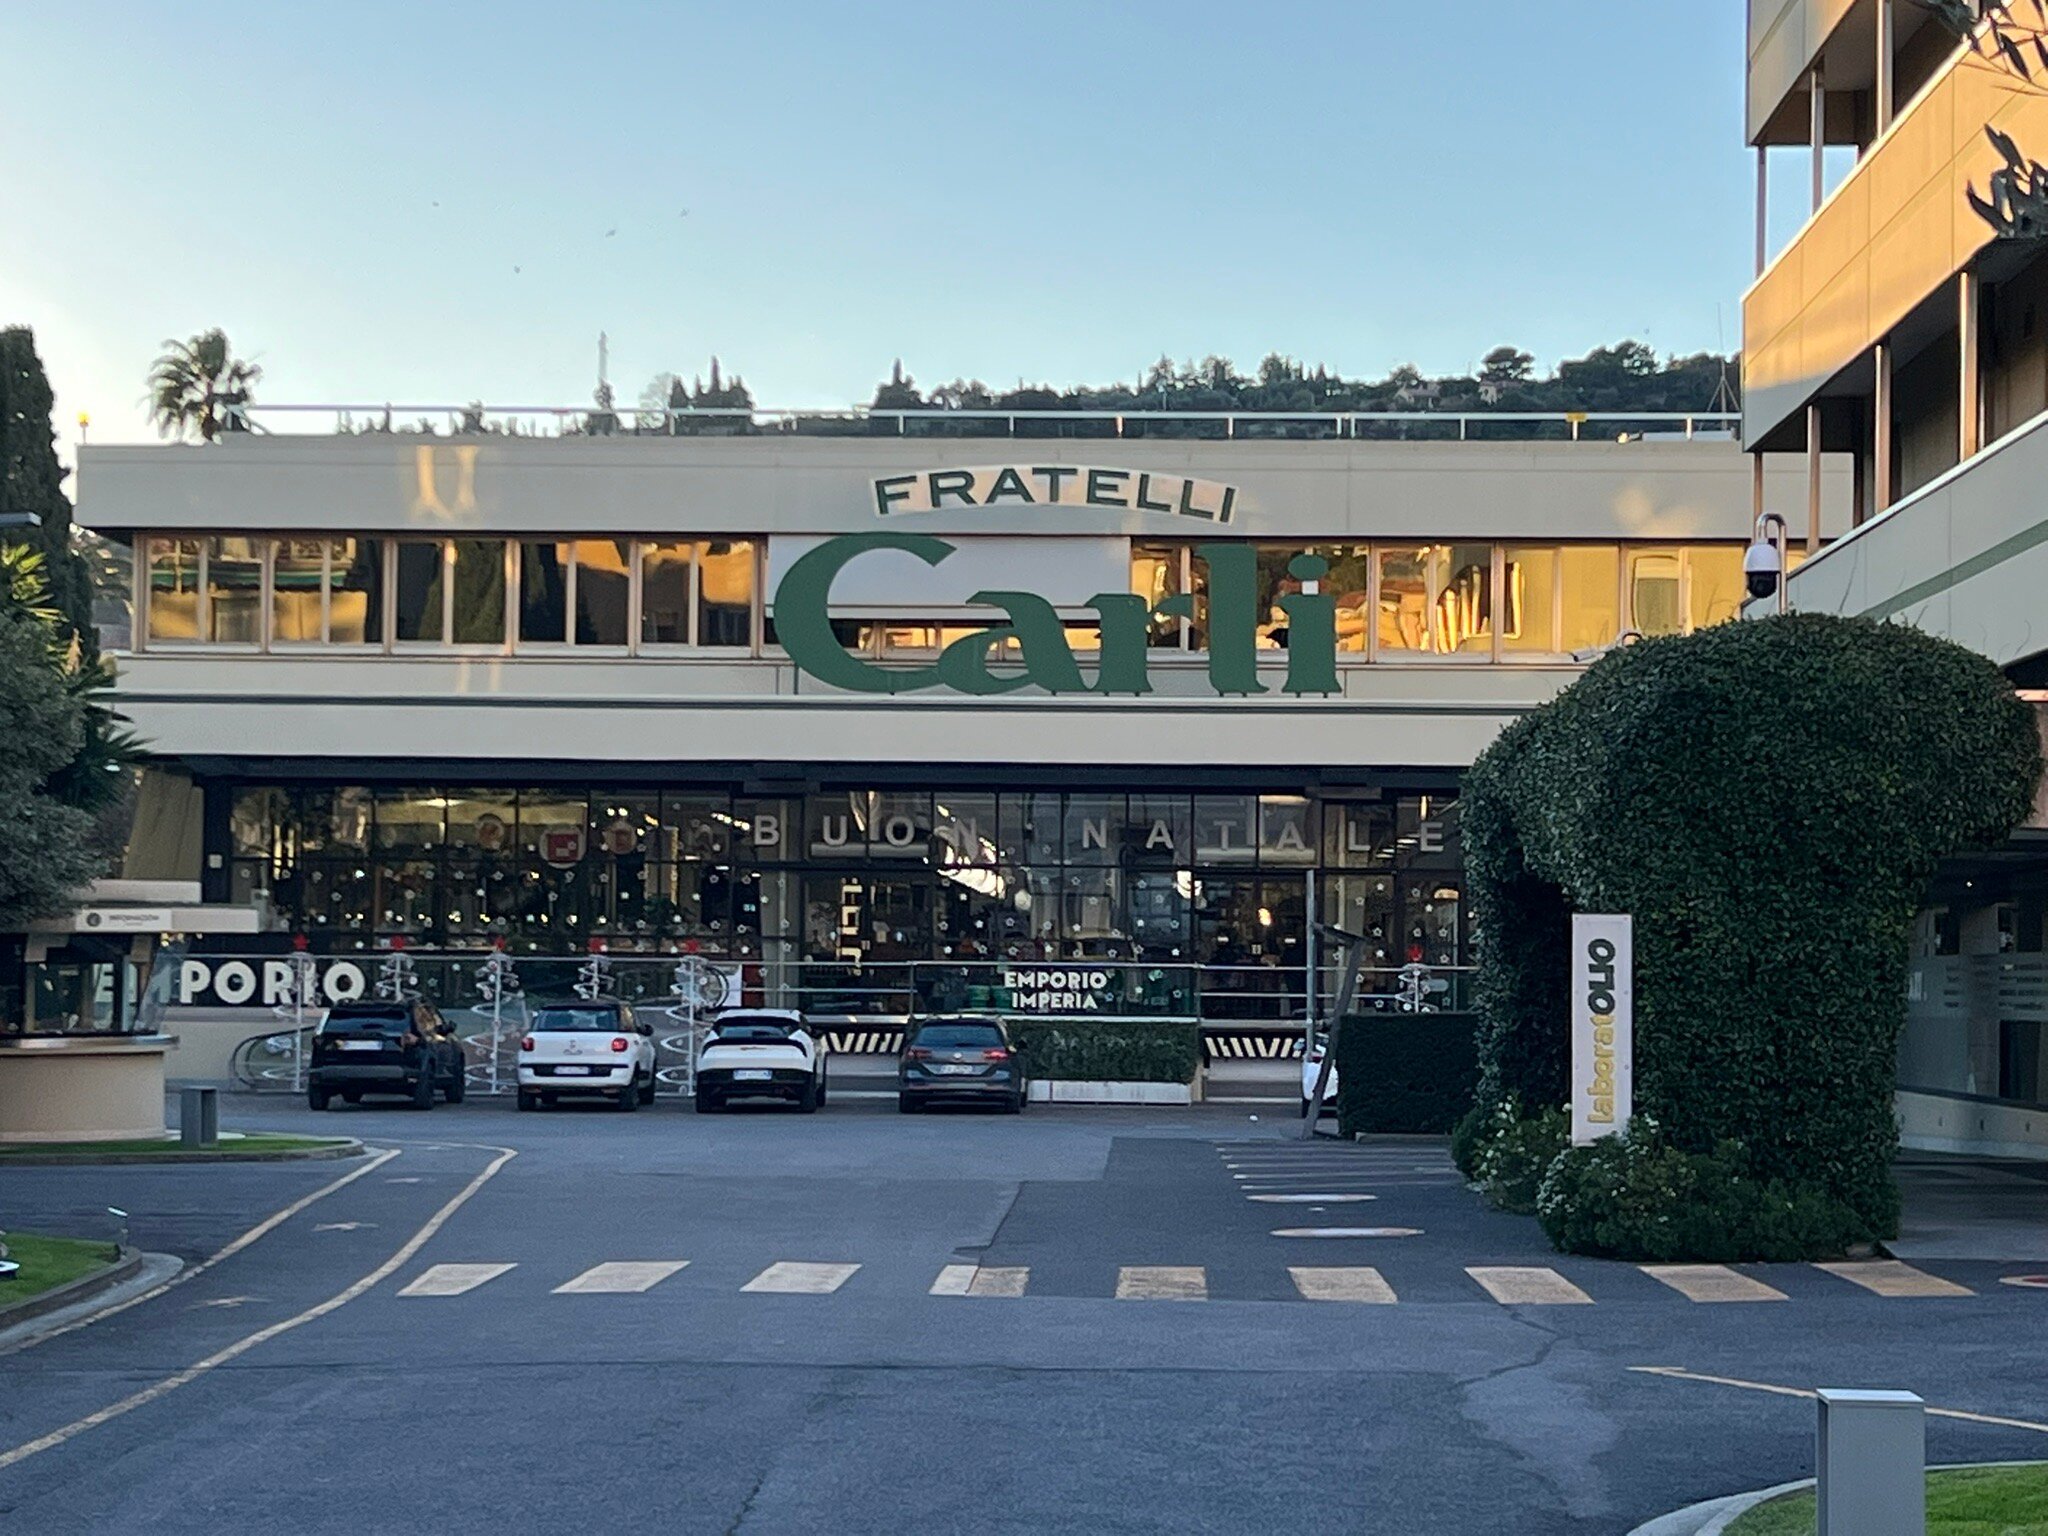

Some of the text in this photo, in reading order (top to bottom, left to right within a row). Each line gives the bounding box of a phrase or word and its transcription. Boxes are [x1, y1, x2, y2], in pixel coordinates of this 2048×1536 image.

[874, 467, 1236, 524] FRATELLI
[773, 531, 1342, 695] Carli
[754, 815, 1444, 858] BUON NATALE
[1004, 971, 1107, 989] EMPORIO
[1011, 991, 1098, 1009] IMPERIA
